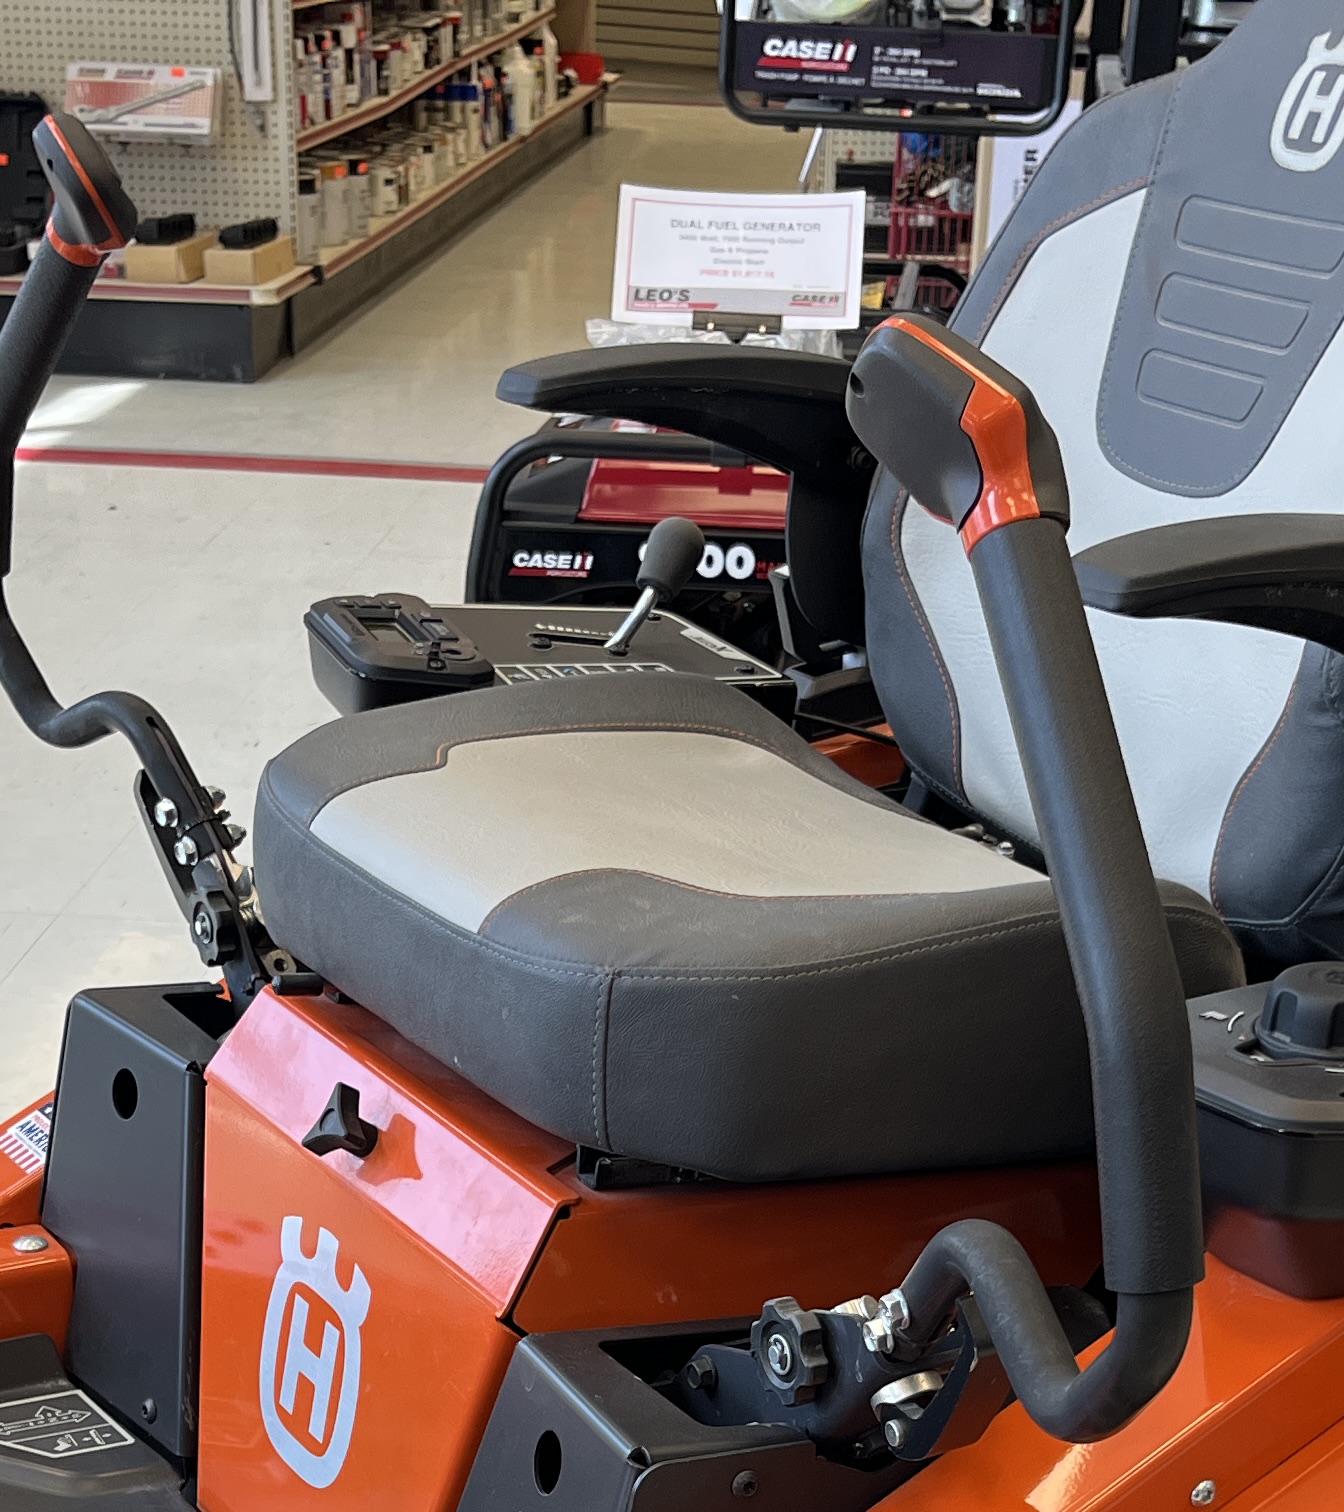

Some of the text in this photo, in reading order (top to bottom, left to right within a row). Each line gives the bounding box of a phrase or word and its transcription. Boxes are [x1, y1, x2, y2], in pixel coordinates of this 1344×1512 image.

[763, 38, 833, 60] CASE
[670, 219, 821, 232] DUAL FUEL GENERATOR
[634, 288, 691, 302] LEO'S
[512, 550, 573, 570] CASE
